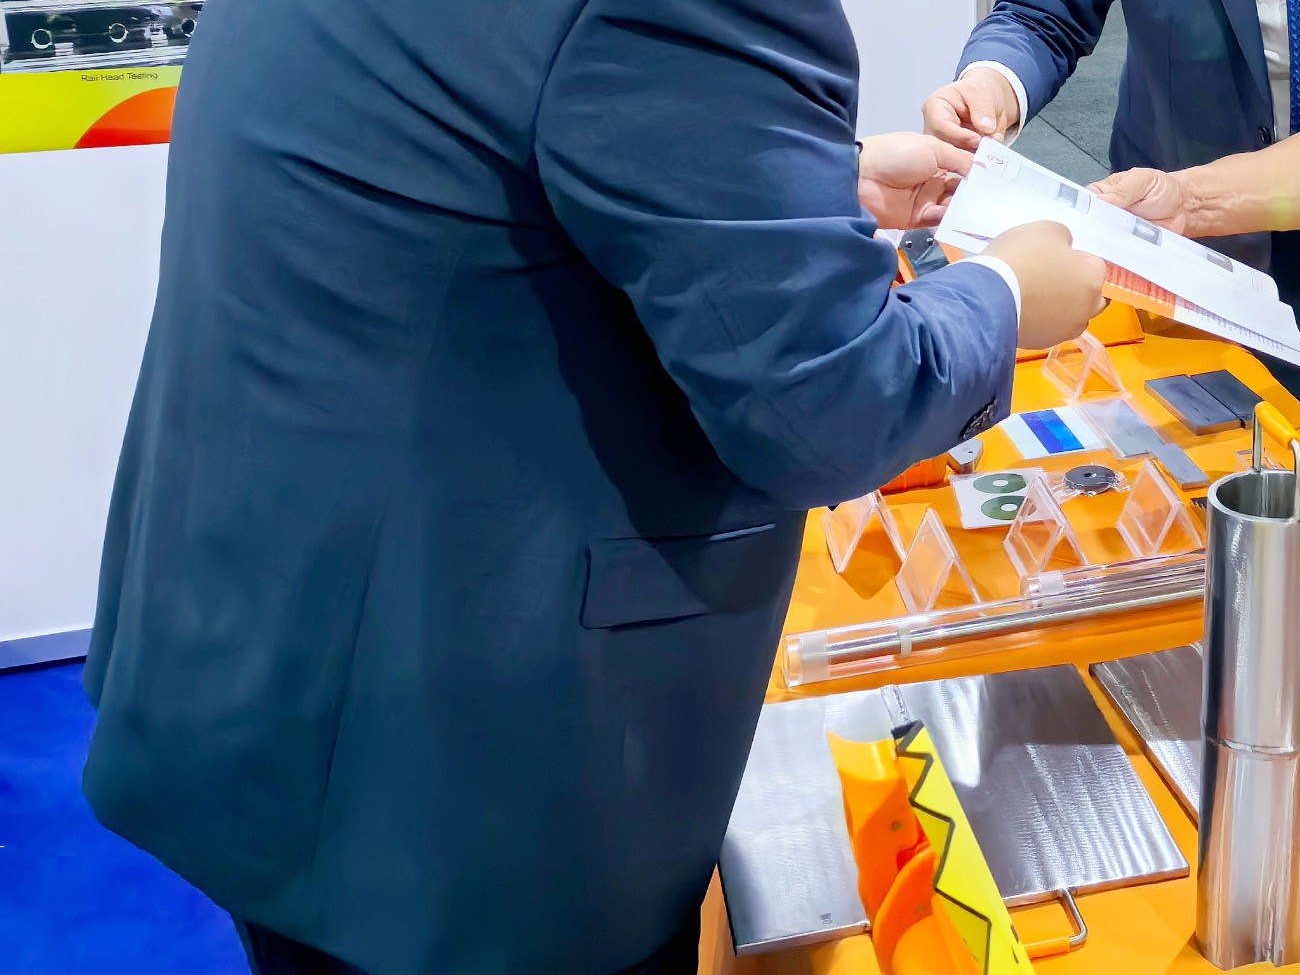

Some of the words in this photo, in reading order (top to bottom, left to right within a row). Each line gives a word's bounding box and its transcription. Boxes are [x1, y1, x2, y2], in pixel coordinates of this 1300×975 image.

[81, 74, 99, 82] Rail
[101, 73, 125, 81] Head
[127, 72, 158, 80] Testing
